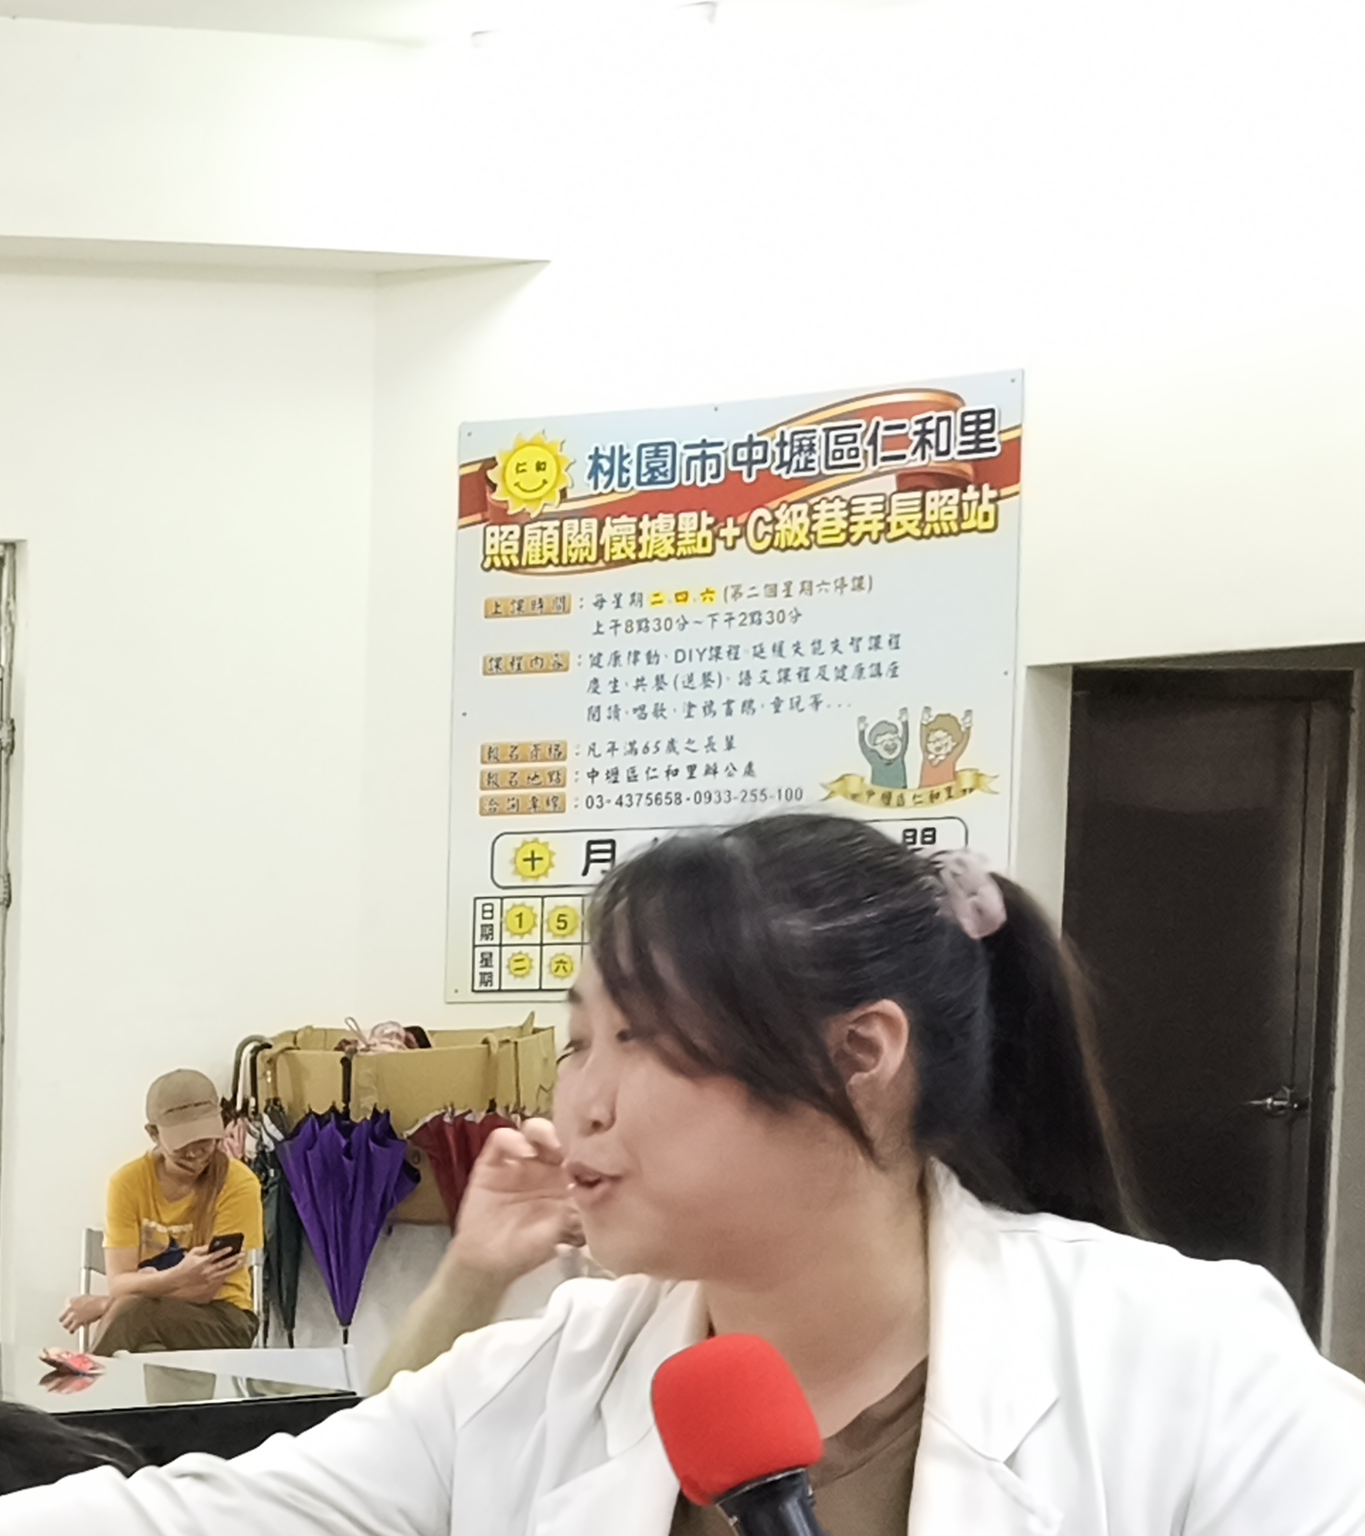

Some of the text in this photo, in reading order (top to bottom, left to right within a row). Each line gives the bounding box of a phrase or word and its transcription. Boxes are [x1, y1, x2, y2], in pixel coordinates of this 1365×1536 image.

[586, 407, 998, 491] 桃園市中壢區仁和里
[514, 460, 547, 475] 仁和
[481, 483, 999, 571] 照顧關懷據點+C級巷弄長照站
[580, 838, 617, 877] 月
[479, 902, 495, 942] 日期
[514, 912, 524, 930] 1
[555, 913, 569, 931] 5
[478, 951, 494, 988] 星期
[512, 957, 527, 972] 二
[552, 959, 569, 974] 六
